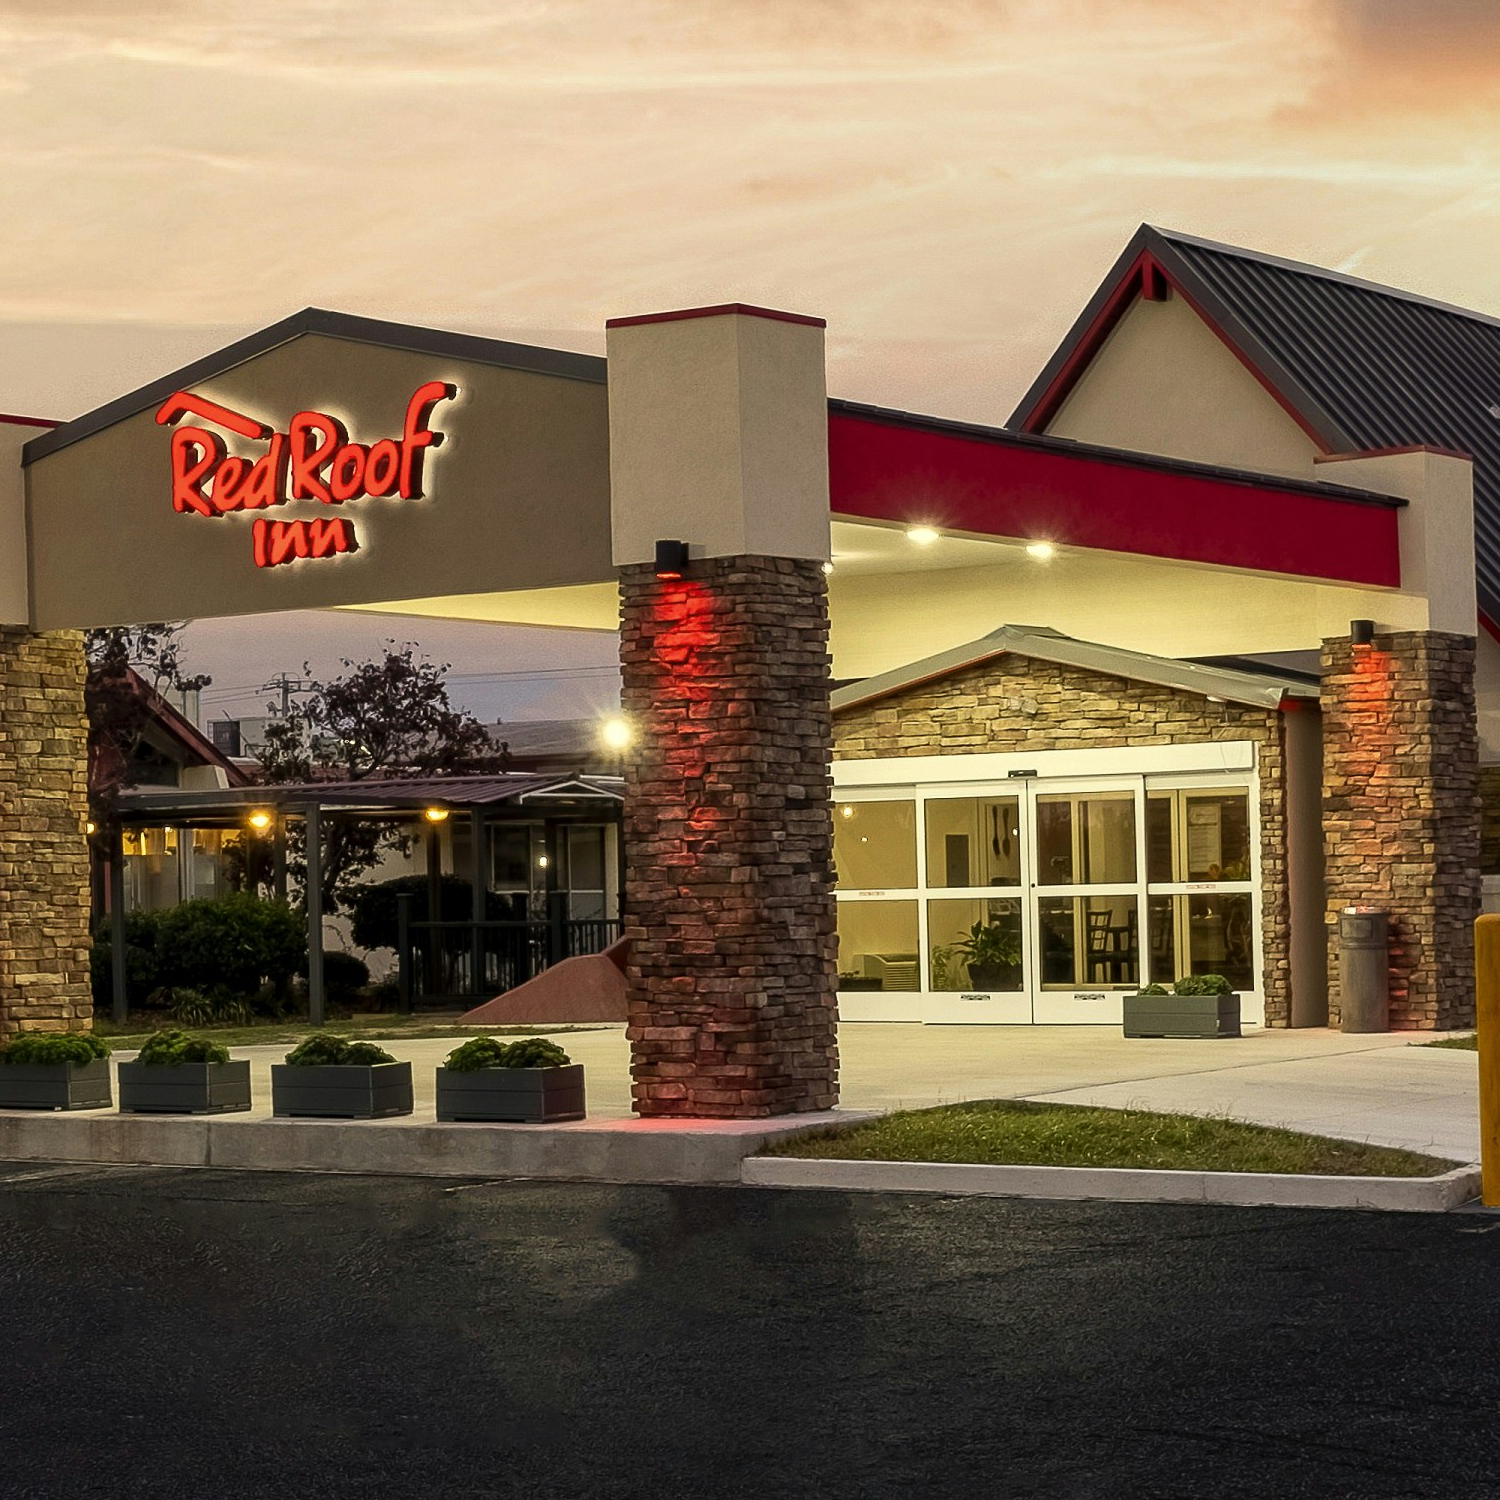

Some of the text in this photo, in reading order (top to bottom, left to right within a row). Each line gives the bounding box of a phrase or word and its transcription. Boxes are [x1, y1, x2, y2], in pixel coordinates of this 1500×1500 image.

[170, 380, 448, 517] Red Roof
[252, 517, 350, 567] Inn
